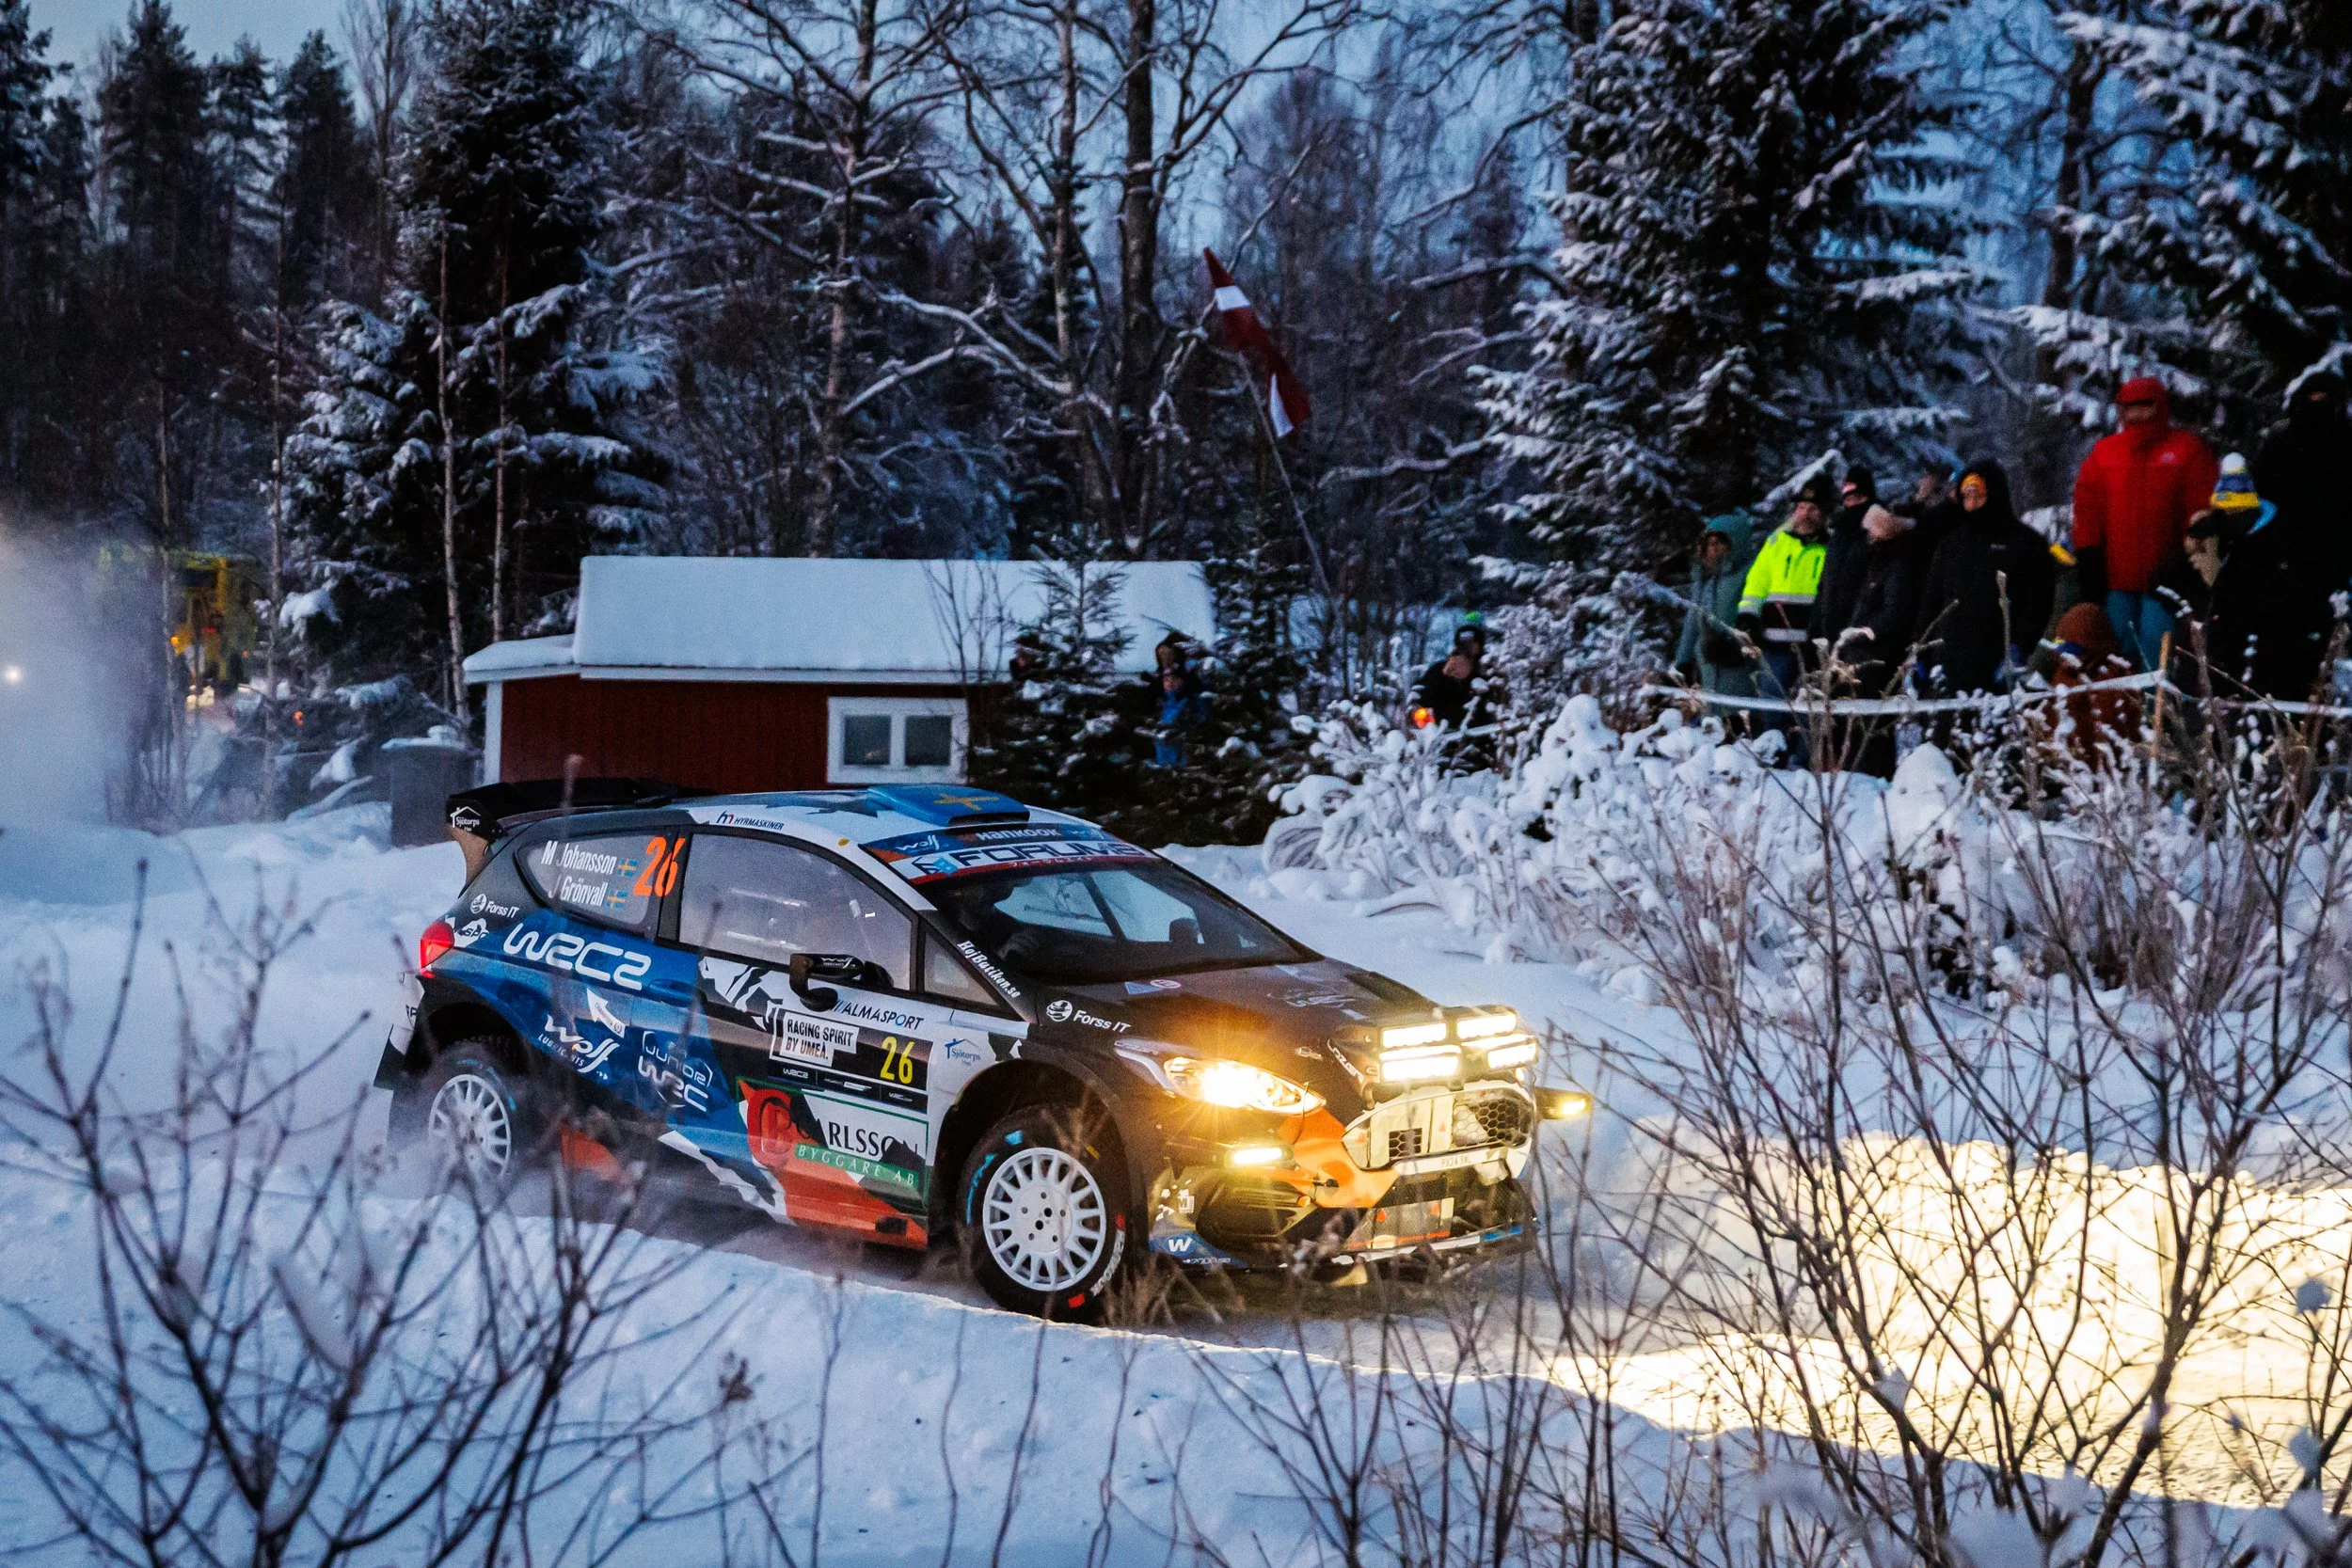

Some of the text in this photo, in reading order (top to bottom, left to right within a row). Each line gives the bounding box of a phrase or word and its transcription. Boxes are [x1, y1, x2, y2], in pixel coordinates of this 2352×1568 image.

[734, 817, 785, 831] HYRMASKINER
[541, 840, 617, 875] M Johansson
[633, 836, 686, 897] 26
[548, 875, 609, 907] J Grönvall
[485, 900, 520, 919] Forss IT
[502, 923, 652, 990] WRC2
[787, 1019, 854, 1047] RACING SPIRIT
[1073, 1009, 1131, 1033] Forss IT
[785, 1037, 799, 1052] BY
[951, 1048, 981, 1062] Sjötorps
[880, 1036, 915, 1085] 26
[798, 1145, 915, 1186] BYGGARE AB
